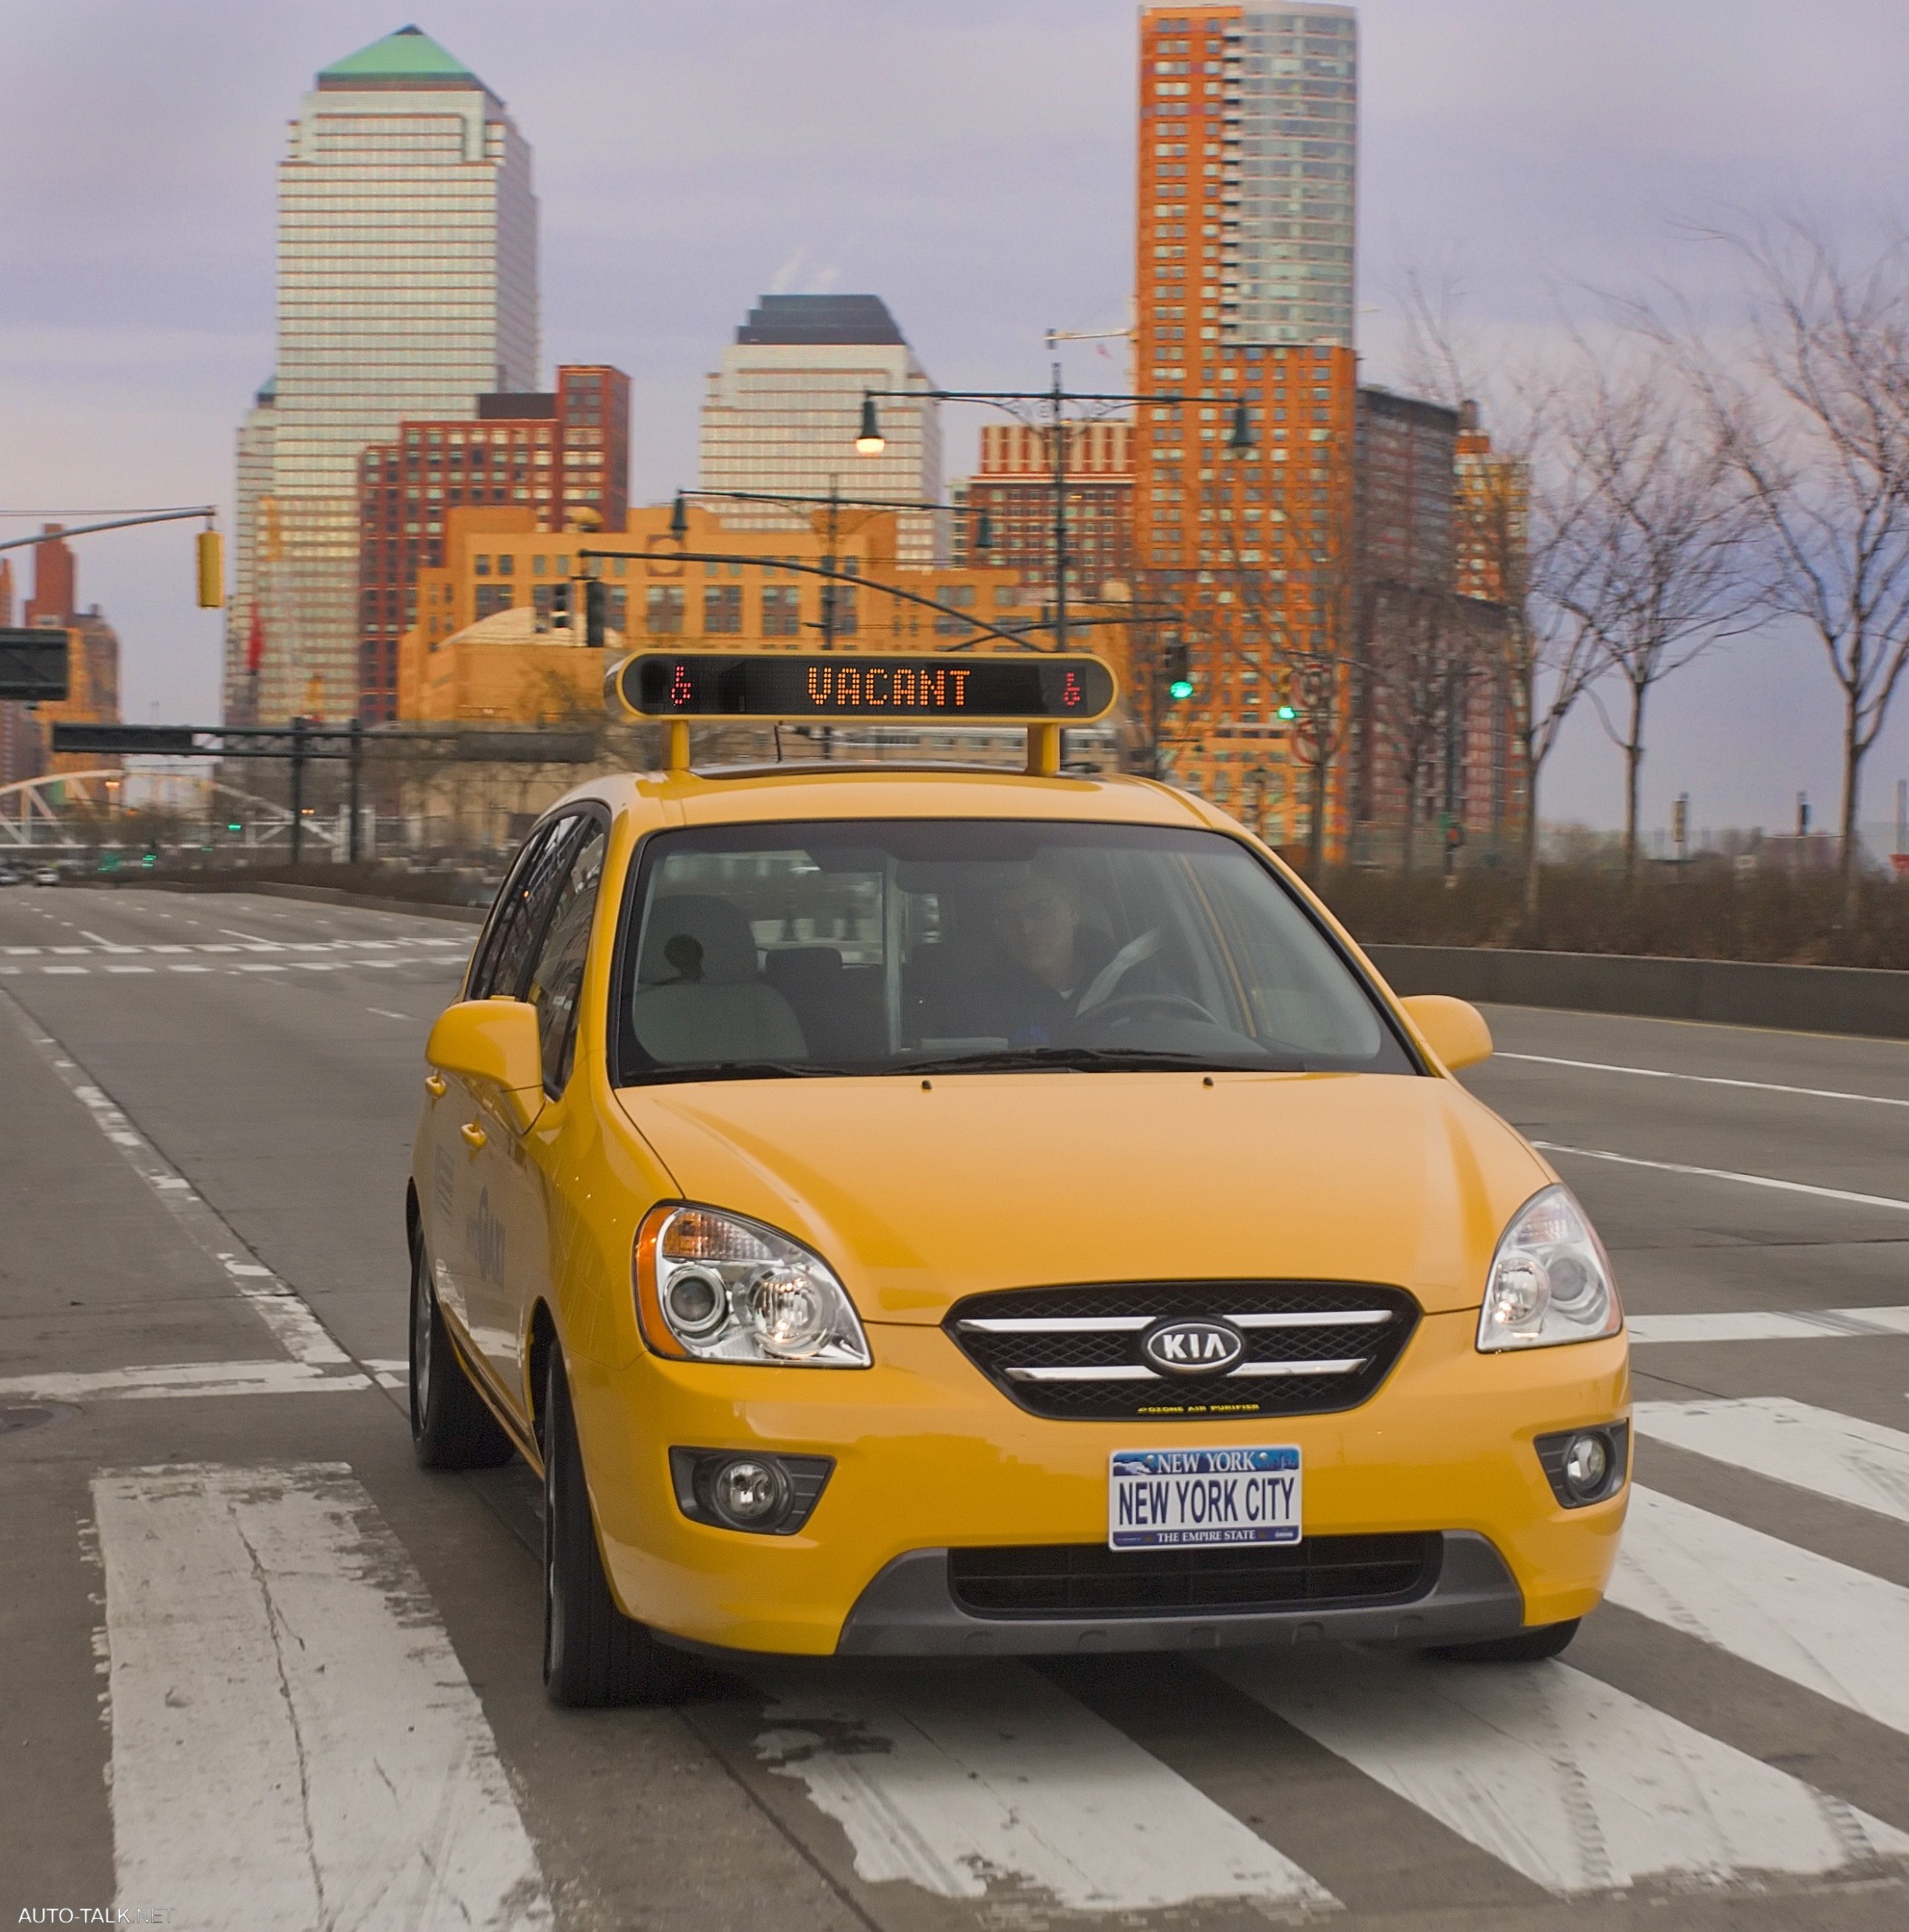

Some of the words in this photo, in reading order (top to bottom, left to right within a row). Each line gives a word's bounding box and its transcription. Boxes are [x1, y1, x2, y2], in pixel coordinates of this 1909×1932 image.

[808, 667, 972, 706] VACANT
[1163, 1333, 1227, 1359] KIA
[1210, 1403, 1260, 1412] PURIFIER
[1157, 1453, 1200, 1473] NEW
[1206, 1451, 1256, 1472] YORK
[1119, 1481, 1170, 1525] NEW
[1176, 1479, 1239, 1524] YORK
[1245, 1476, 1295, 1522] CITY
[1157, 1532, 1179, 1543] THE
[1182, 1531, 1221, 1541] EMPIRE
[1224, 1529, 1256, 1540] STATE
